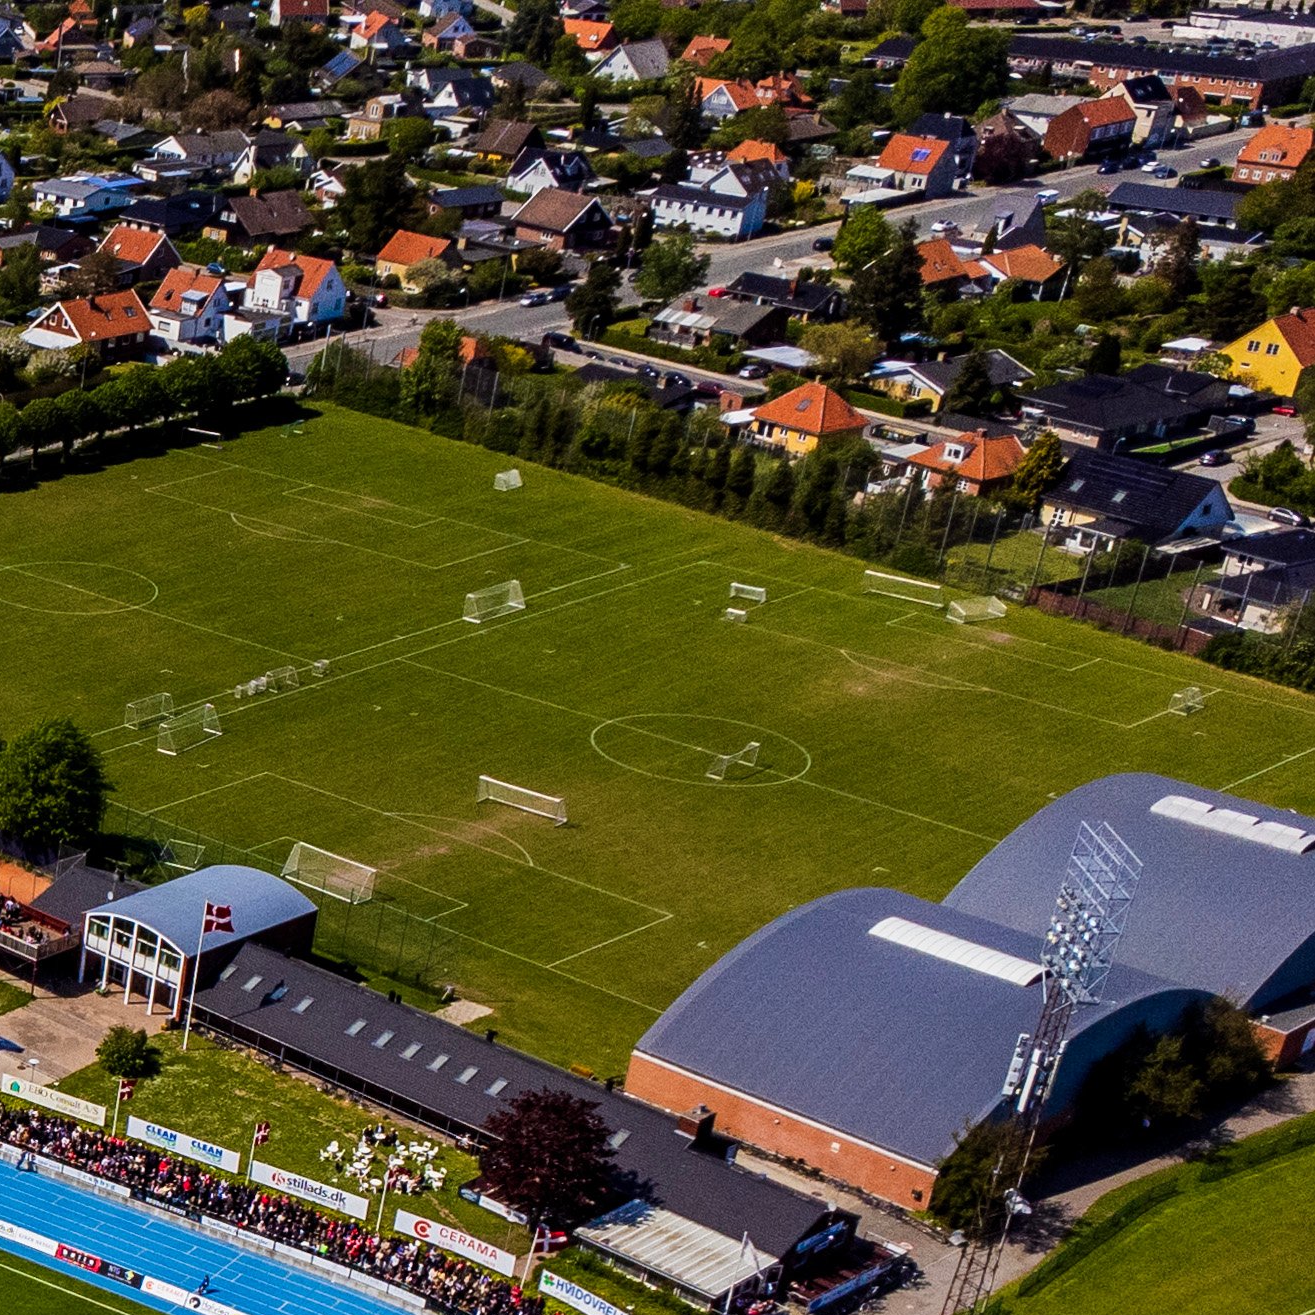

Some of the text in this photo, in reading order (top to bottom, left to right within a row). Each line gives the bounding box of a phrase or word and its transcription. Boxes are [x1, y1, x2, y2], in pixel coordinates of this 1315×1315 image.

[146, 1124, 177, 1142] CLEAN
[191, 1140, 223, 1158] CLEAN
[286, 1177, 347, 1205] stillads.dk
[439, 1226, 499, 1261] CERAMA
